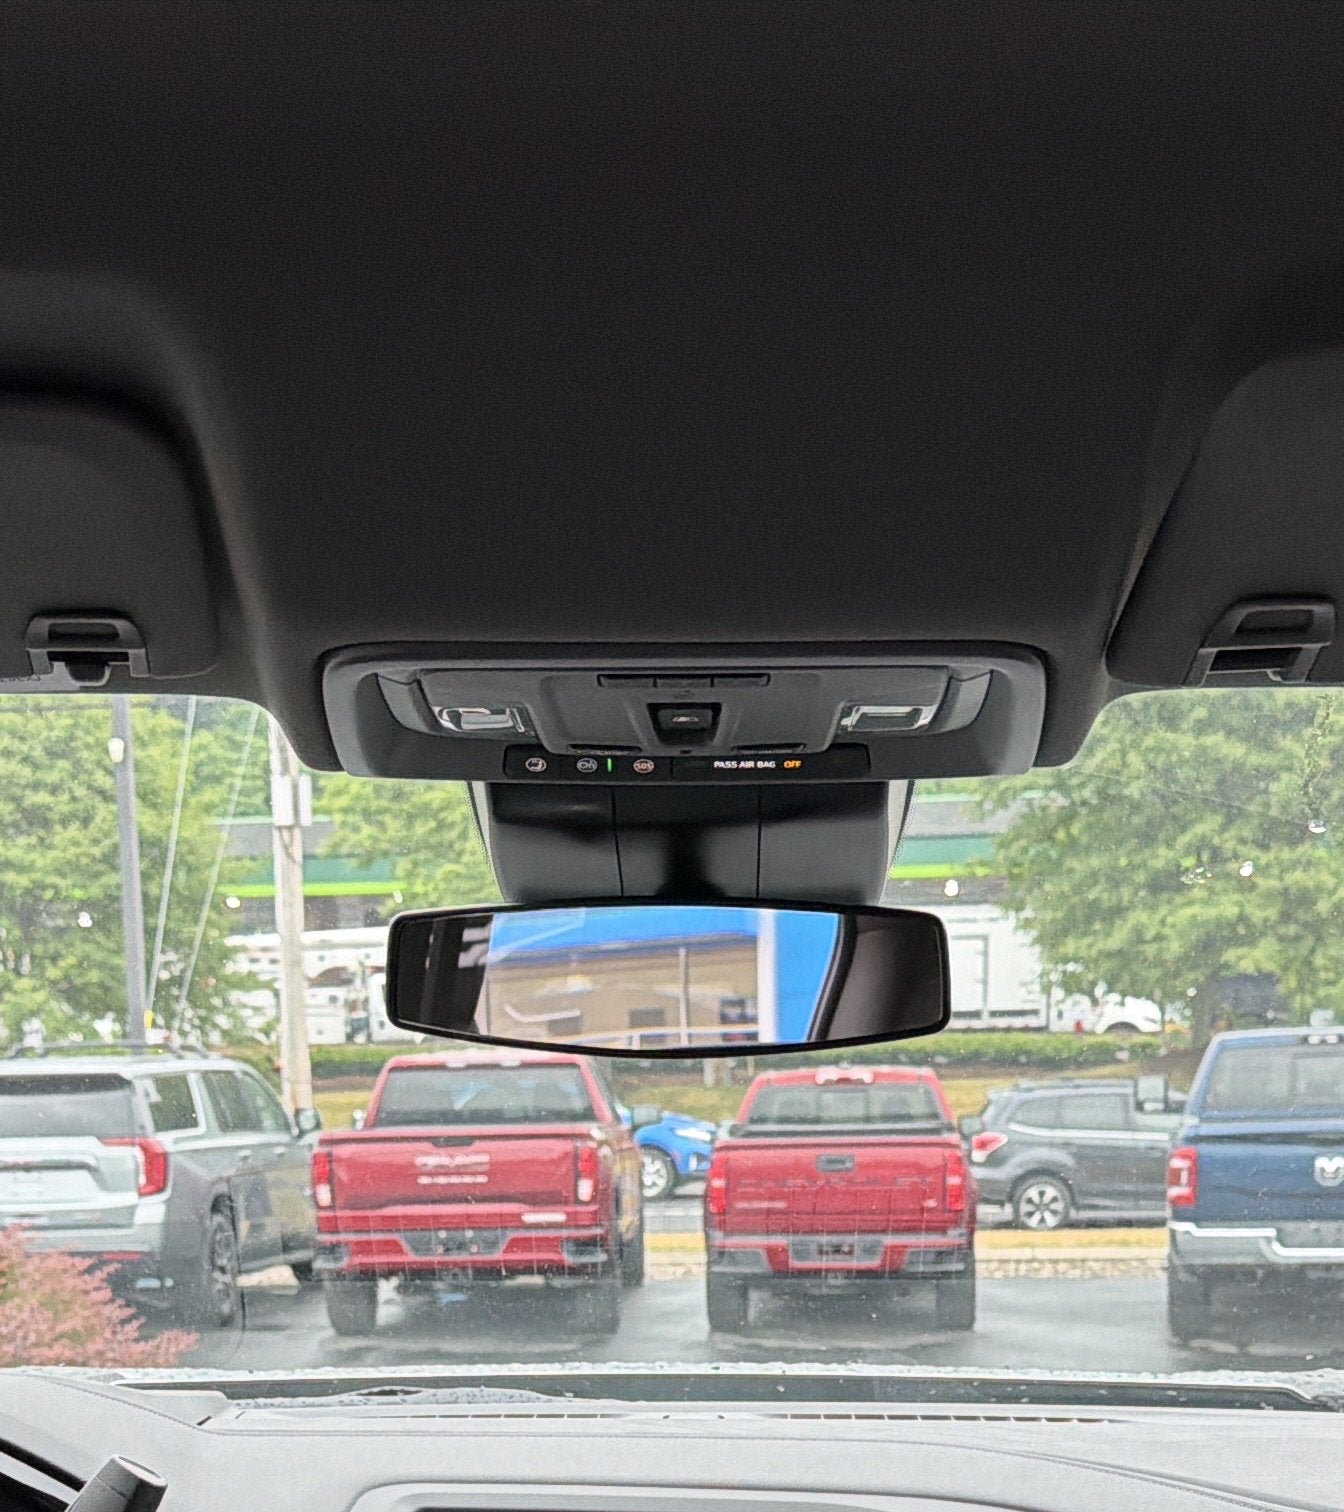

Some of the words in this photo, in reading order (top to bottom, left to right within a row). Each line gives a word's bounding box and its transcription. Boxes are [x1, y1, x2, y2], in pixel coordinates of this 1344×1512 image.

[713, 760, 737, 769] PASS
[739, 760, 755, 769] AIR
[757, 760, 776, 769] BAG
[783, 760, 801, 769] OFF
